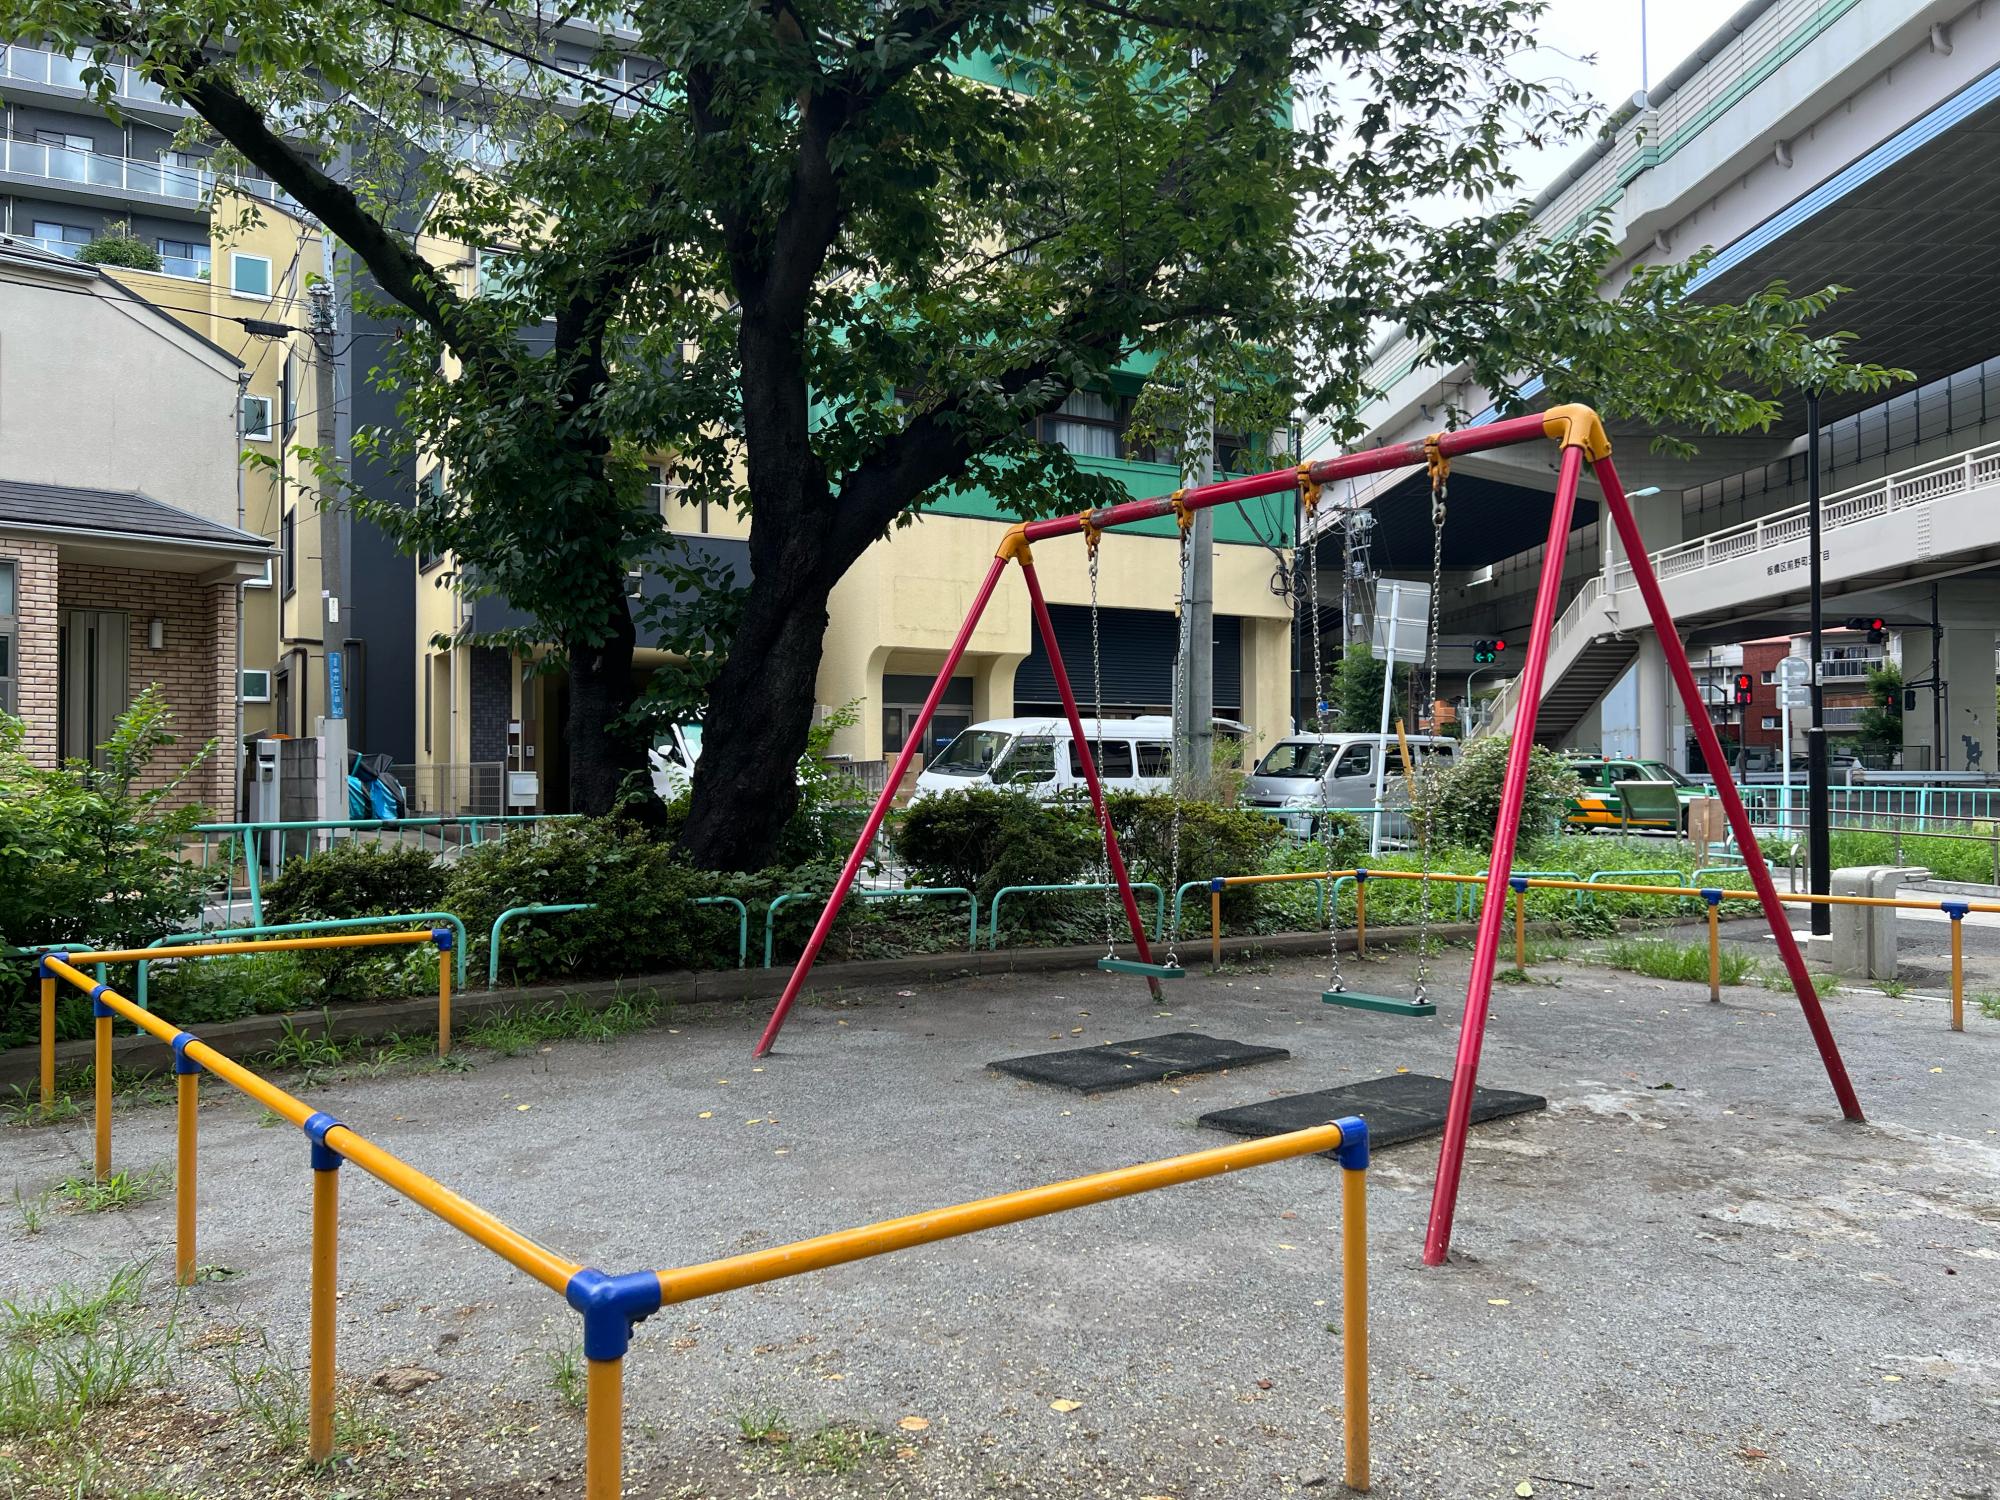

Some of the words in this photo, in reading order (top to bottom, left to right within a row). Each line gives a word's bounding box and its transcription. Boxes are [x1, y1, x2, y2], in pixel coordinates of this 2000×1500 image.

[1766, 550, 1830, 576] 板橋区前野町目
